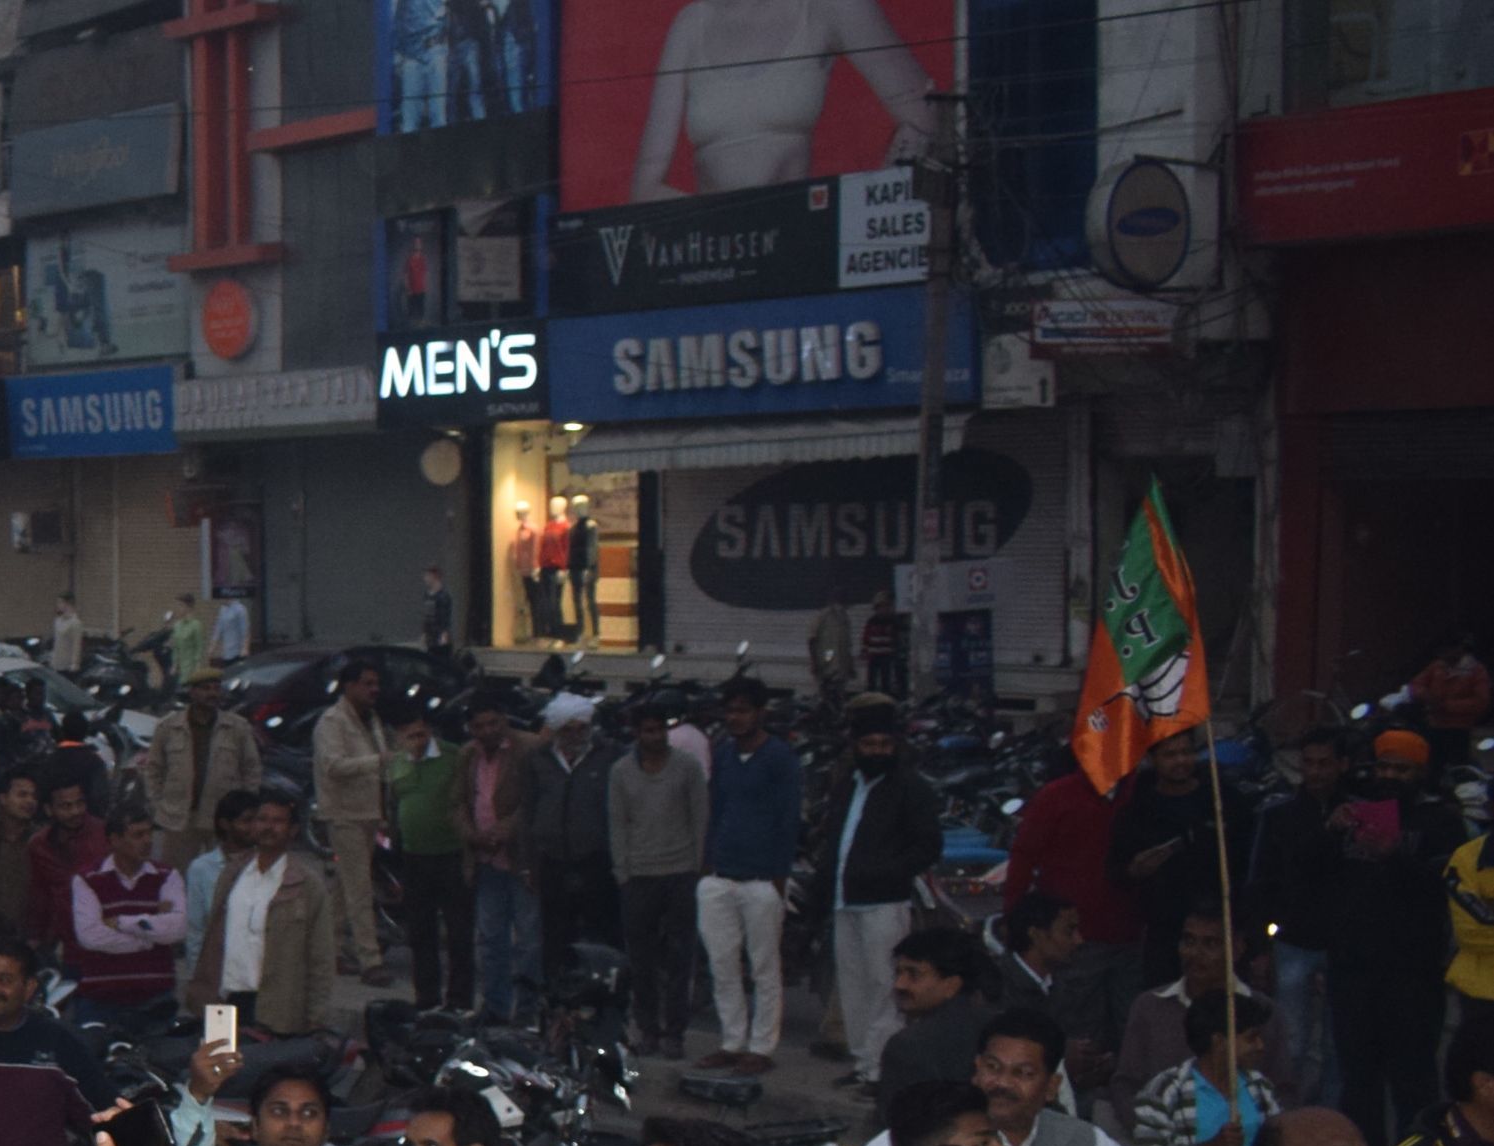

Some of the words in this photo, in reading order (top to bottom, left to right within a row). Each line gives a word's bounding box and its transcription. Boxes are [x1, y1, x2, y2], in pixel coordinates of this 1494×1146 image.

[865, 209, 927, 241] SALES
[379, 329, 538, 399] MEN'S
[613, 320, 883, 396] SAMSUNG
[21, 389, 165, 437] SAMSUNG
